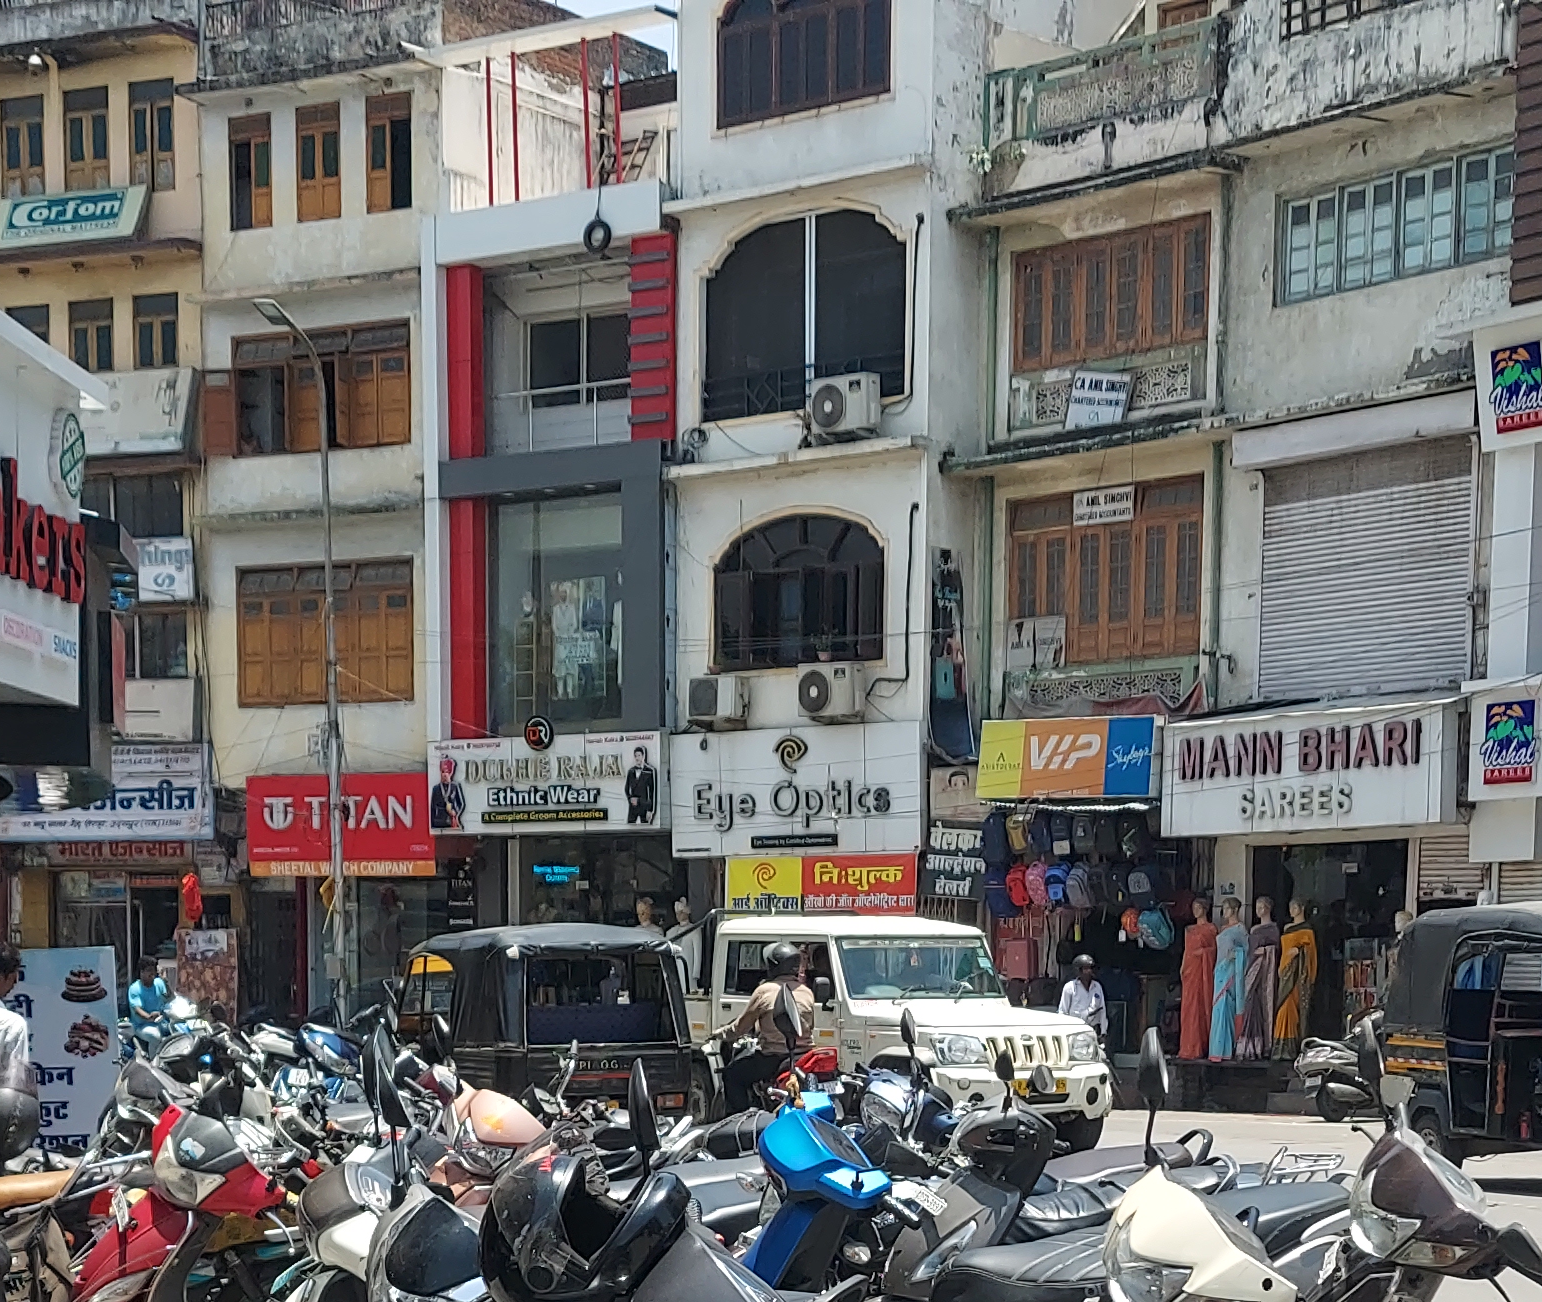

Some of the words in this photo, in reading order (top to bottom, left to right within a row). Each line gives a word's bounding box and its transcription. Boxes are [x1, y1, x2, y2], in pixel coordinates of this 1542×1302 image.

[1030, 734, 1101, 771] VIP
[1178, 731, 1283, 780] MANN
[1298, 718, 1423, 773] BHARI
[1480, 738, 1536, 768] Vishal
[464, 754, 550, 783] DULHE
[555, 752, 624, 780] RAJA
[304, 795, 413, 831] TTAN
[487, 787, 547, 807] Ethnic
[548, 784, 600, 805] Wear
[693, 783, 757, 832] Eye
[769, 779, 891, 829] Optics
[1238, 782, 1353, 821] SAREES
[270, 861, 317, 876] SHEETAL
[360, 861, 414, 876] COMPANY
